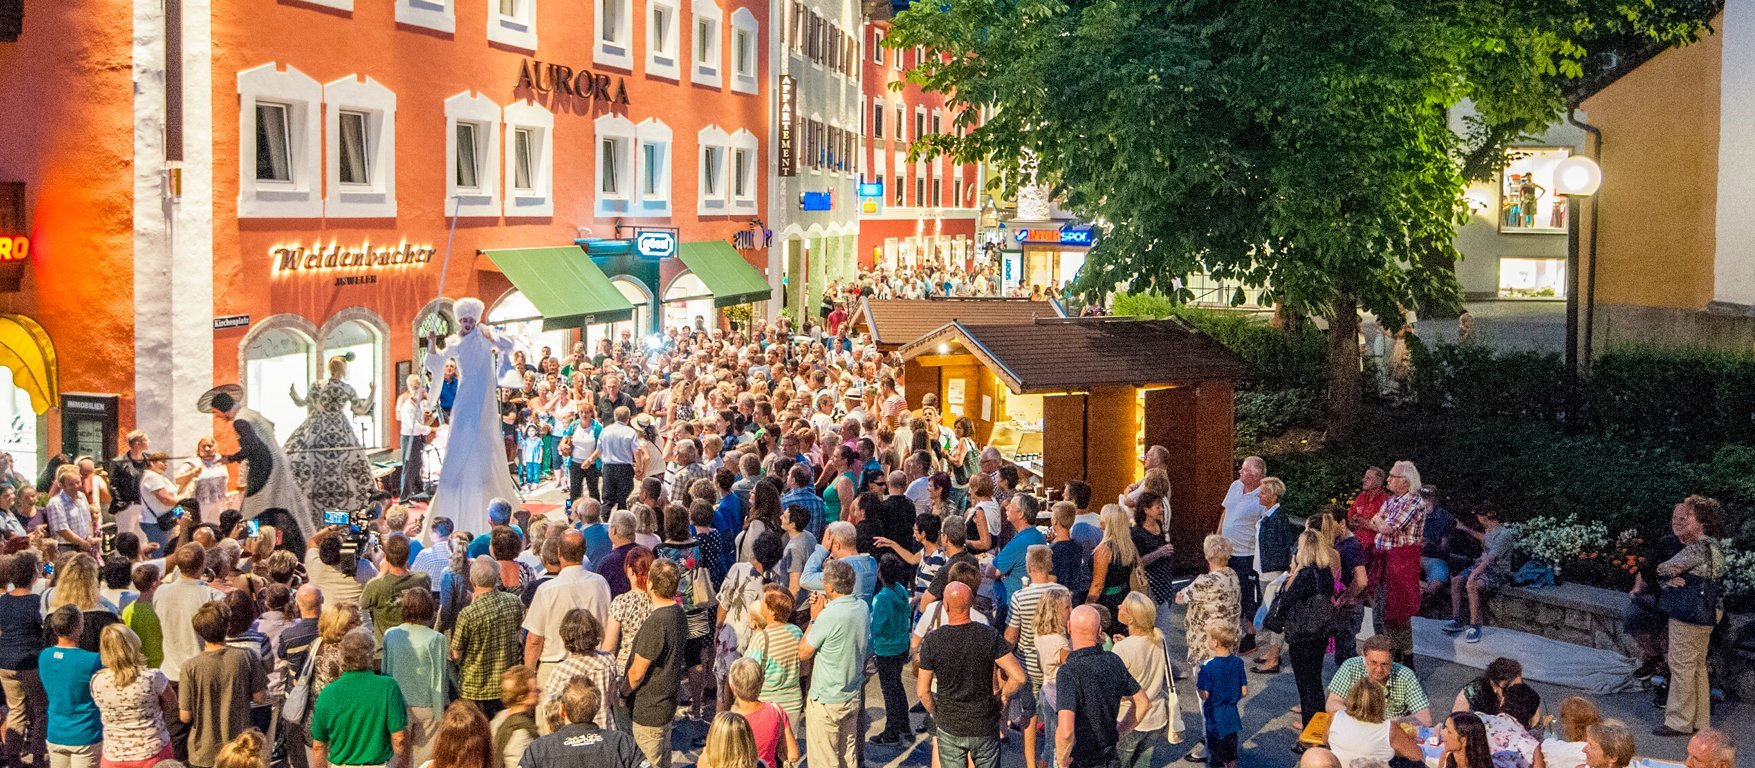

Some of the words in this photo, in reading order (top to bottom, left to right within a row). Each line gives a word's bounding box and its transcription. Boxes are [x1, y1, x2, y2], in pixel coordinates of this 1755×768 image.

[514, 58, 631, 105] AURORA
[781, 75, 791, 176] APPARTEMENT
[274, 243, 437, 271] Weidenbacher
[67, 400, 105, 411] IMMOBILIEN
